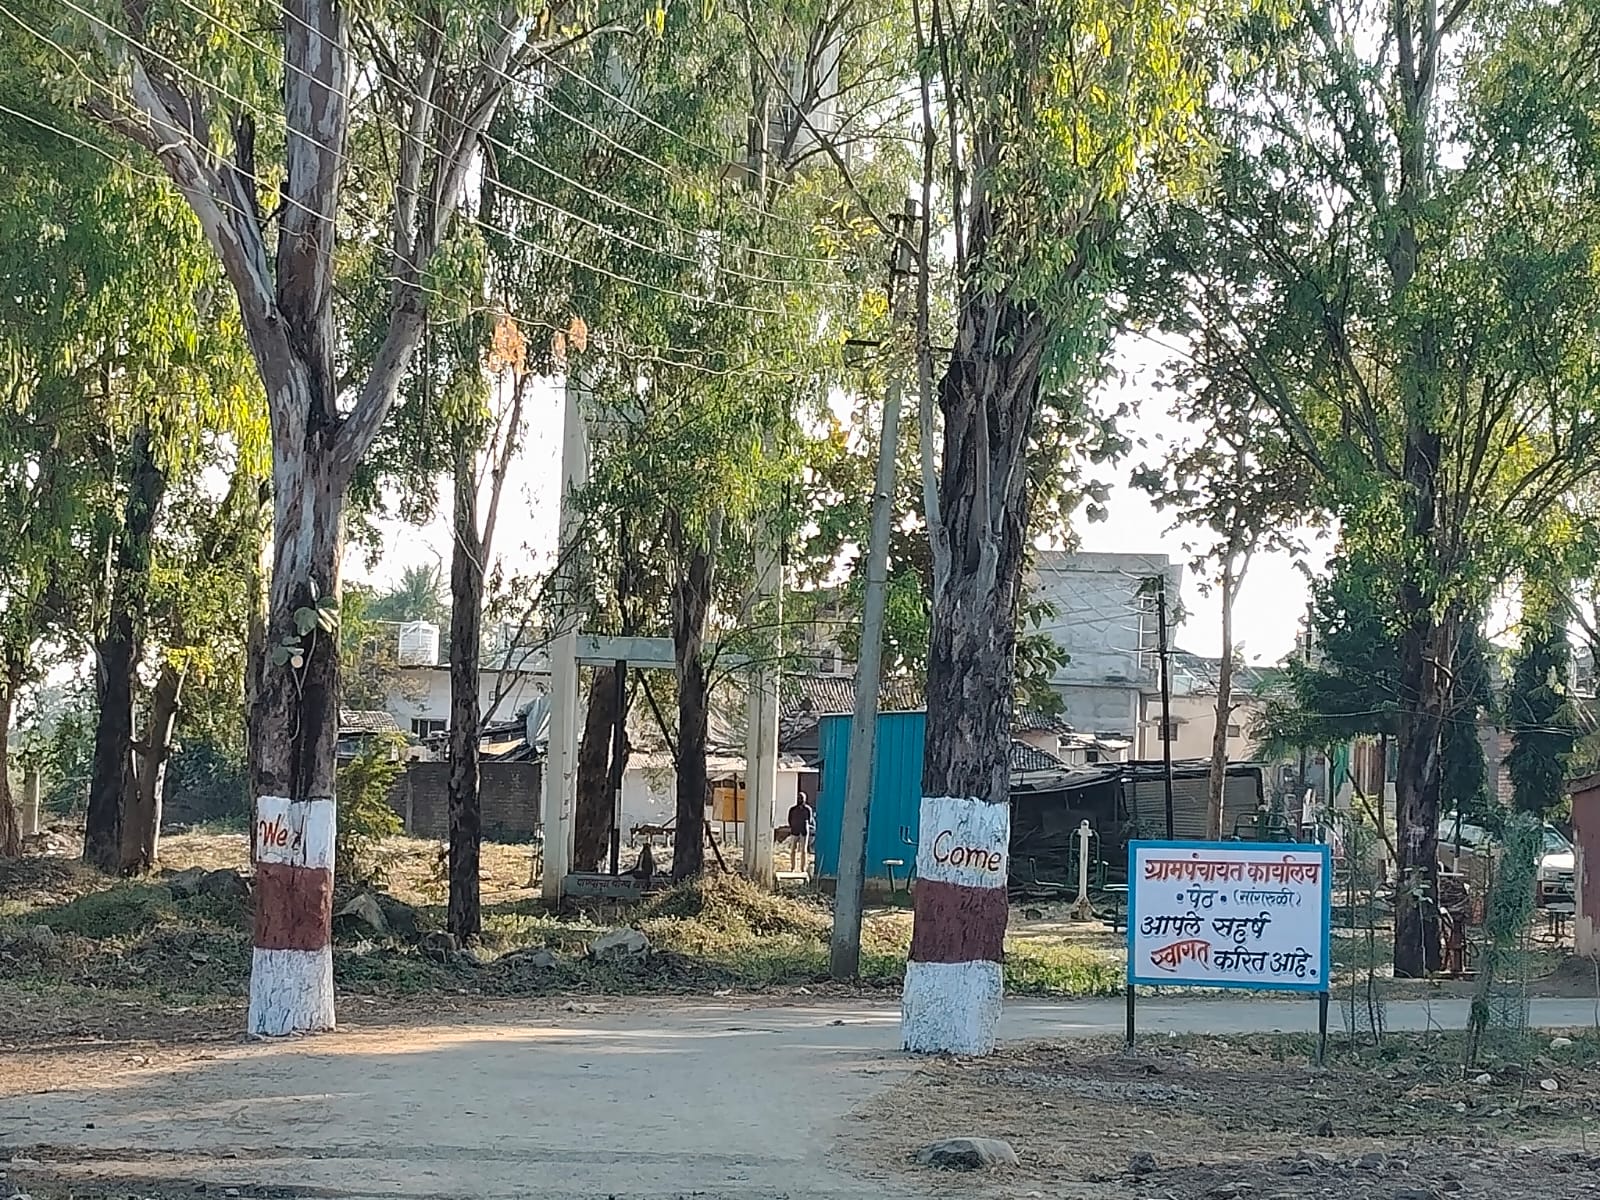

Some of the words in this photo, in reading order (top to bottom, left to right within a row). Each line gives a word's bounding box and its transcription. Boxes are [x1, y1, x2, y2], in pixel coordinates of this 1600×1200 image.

[933, 830, 1002, 872] Come
[1145, 853, 1243, 882] ग्रामपंचायत
[1248, 855, 1320, 884] कार्यालय
[1140, 912, 1204, 936] आपले
[1212, 912, 1271, 944] सहर्ष
[1151, 939, 1211, 972] स्वागत
[1213, 946, 1269, 972] करित
